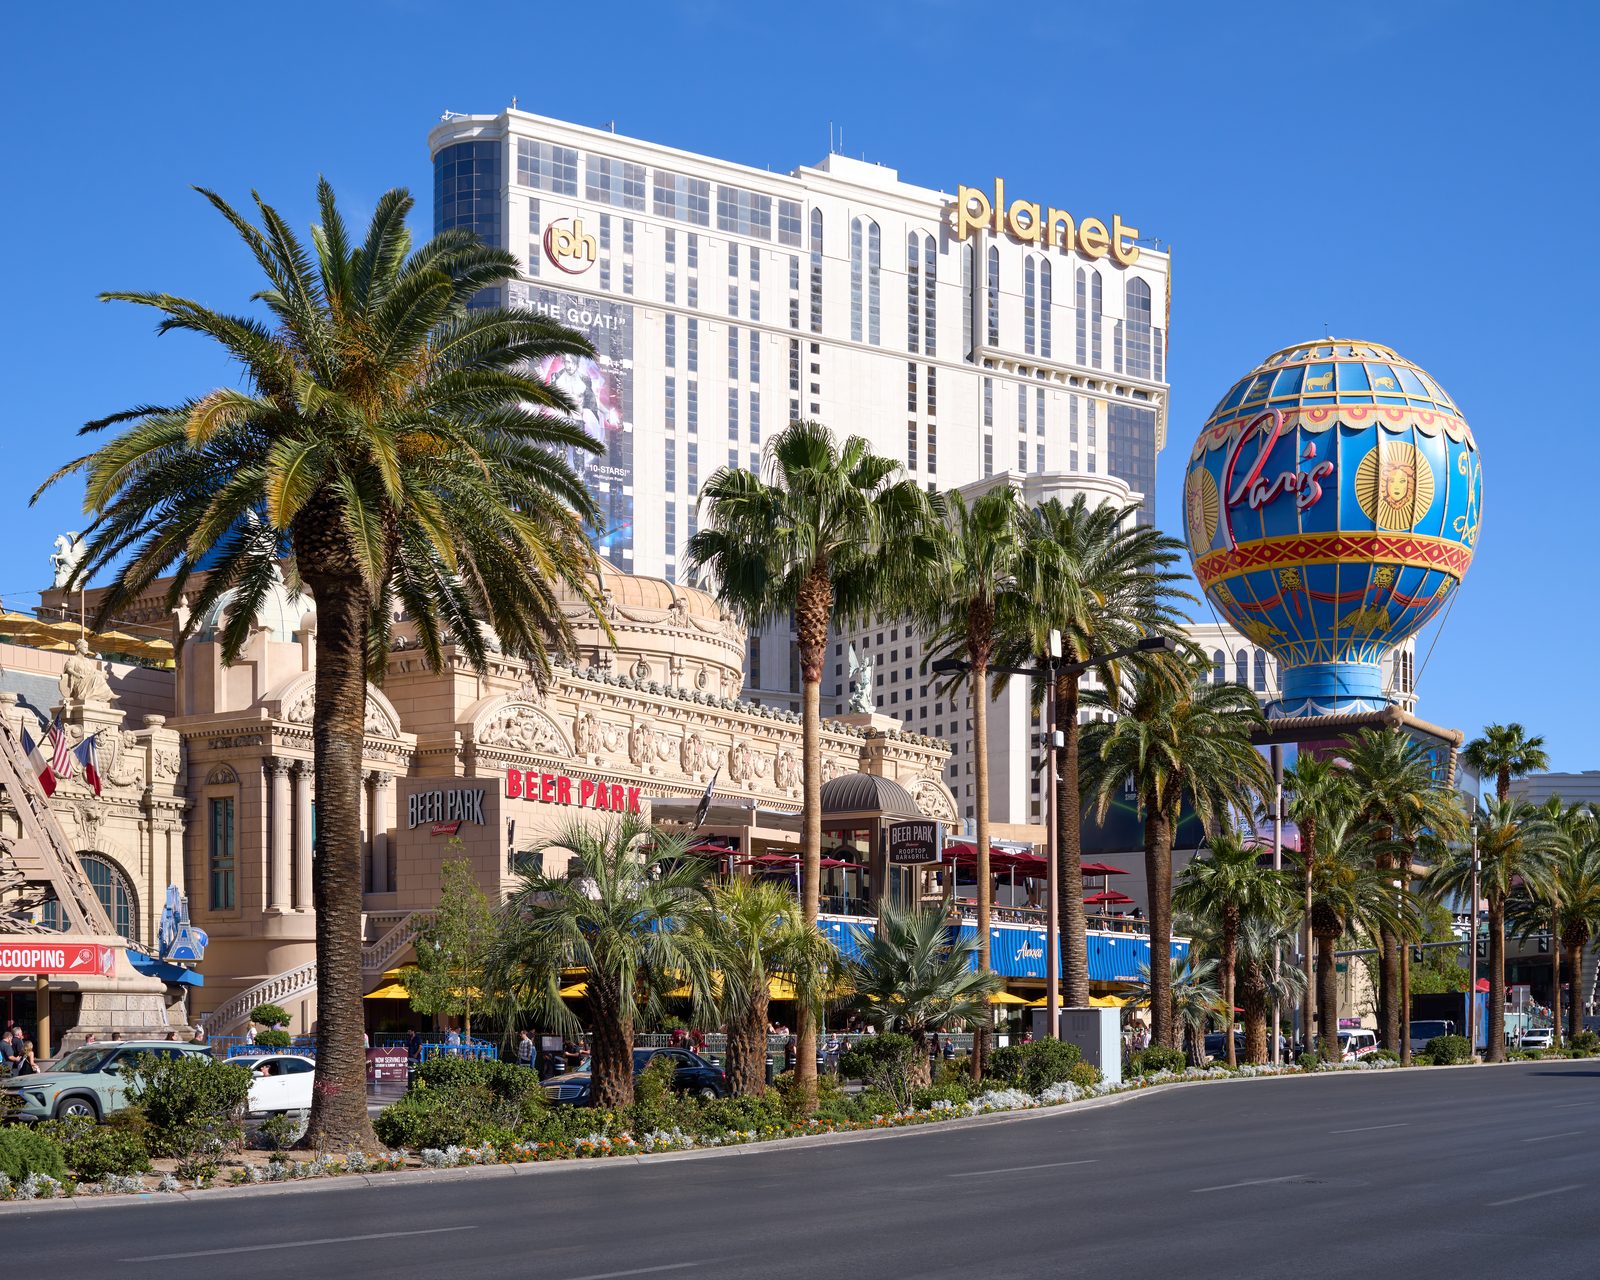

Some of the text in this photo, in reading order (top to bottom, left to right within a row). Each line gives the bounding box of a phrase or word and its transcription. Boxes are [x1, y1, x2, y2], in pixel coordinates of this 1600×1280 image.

[550, 219, 596, 262] ph
[957, 177, 1140, 265] planet
[1219, 408, 1334, 553] Paris
[408, 789, 485, 830] BEER PARK
[507, 768, 641, 815] BEER PARK
[892, 825, 933, 845] BEER PARK
[0, 949, 65, 968] COOPING
